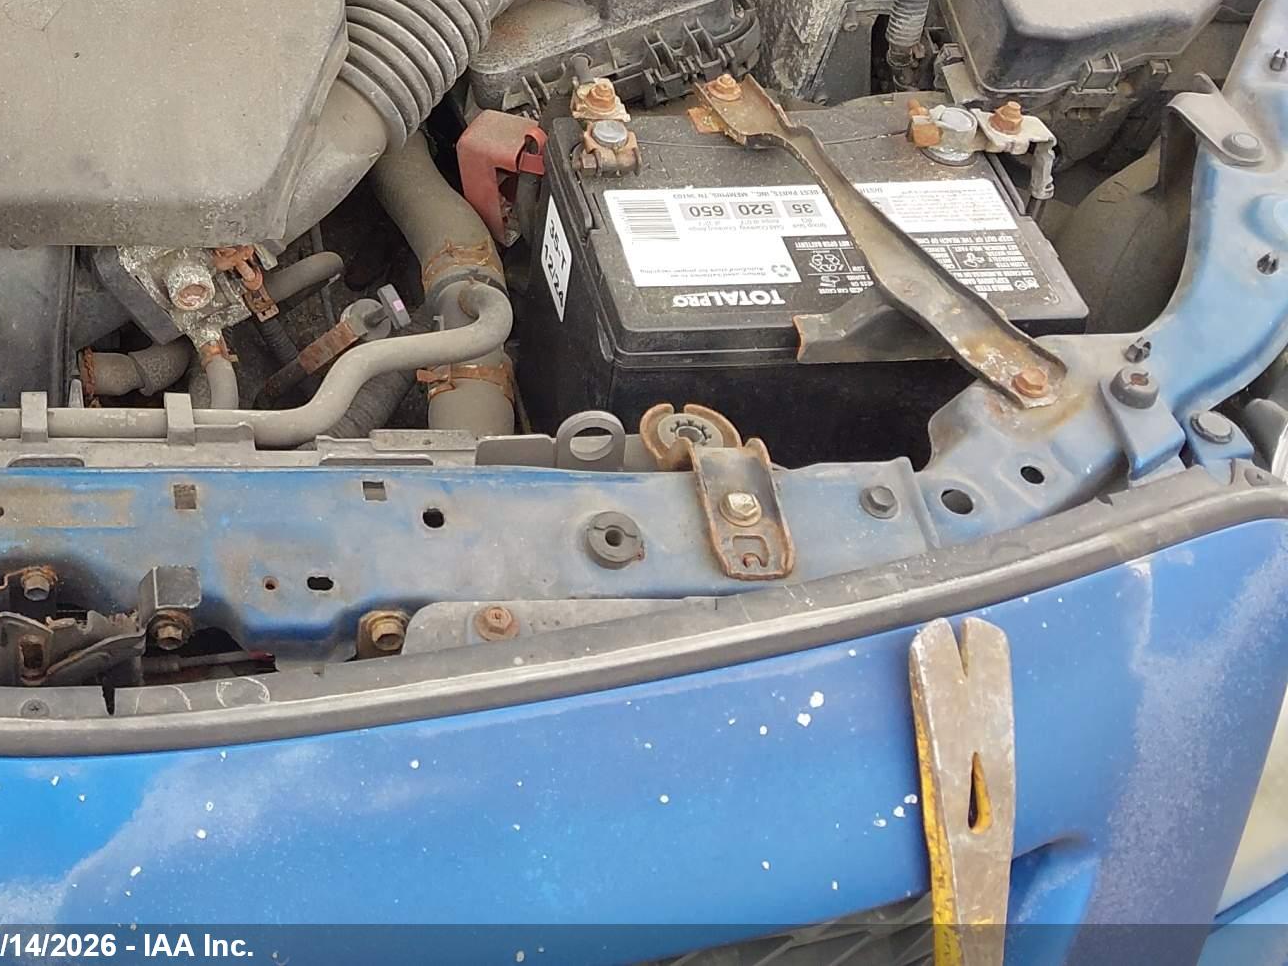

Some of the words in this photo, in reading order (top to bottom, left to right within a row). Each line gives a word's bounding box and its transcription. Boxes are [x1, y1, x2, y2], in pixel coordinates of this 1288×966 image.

[689, 205, 724, 218] 650
[738, 203, 773, 216] 520
[792, 203, 814, 214] 35
[550, 219, 567, 270] 35-T
[671, 289, 786, 307] TOTALPRO
